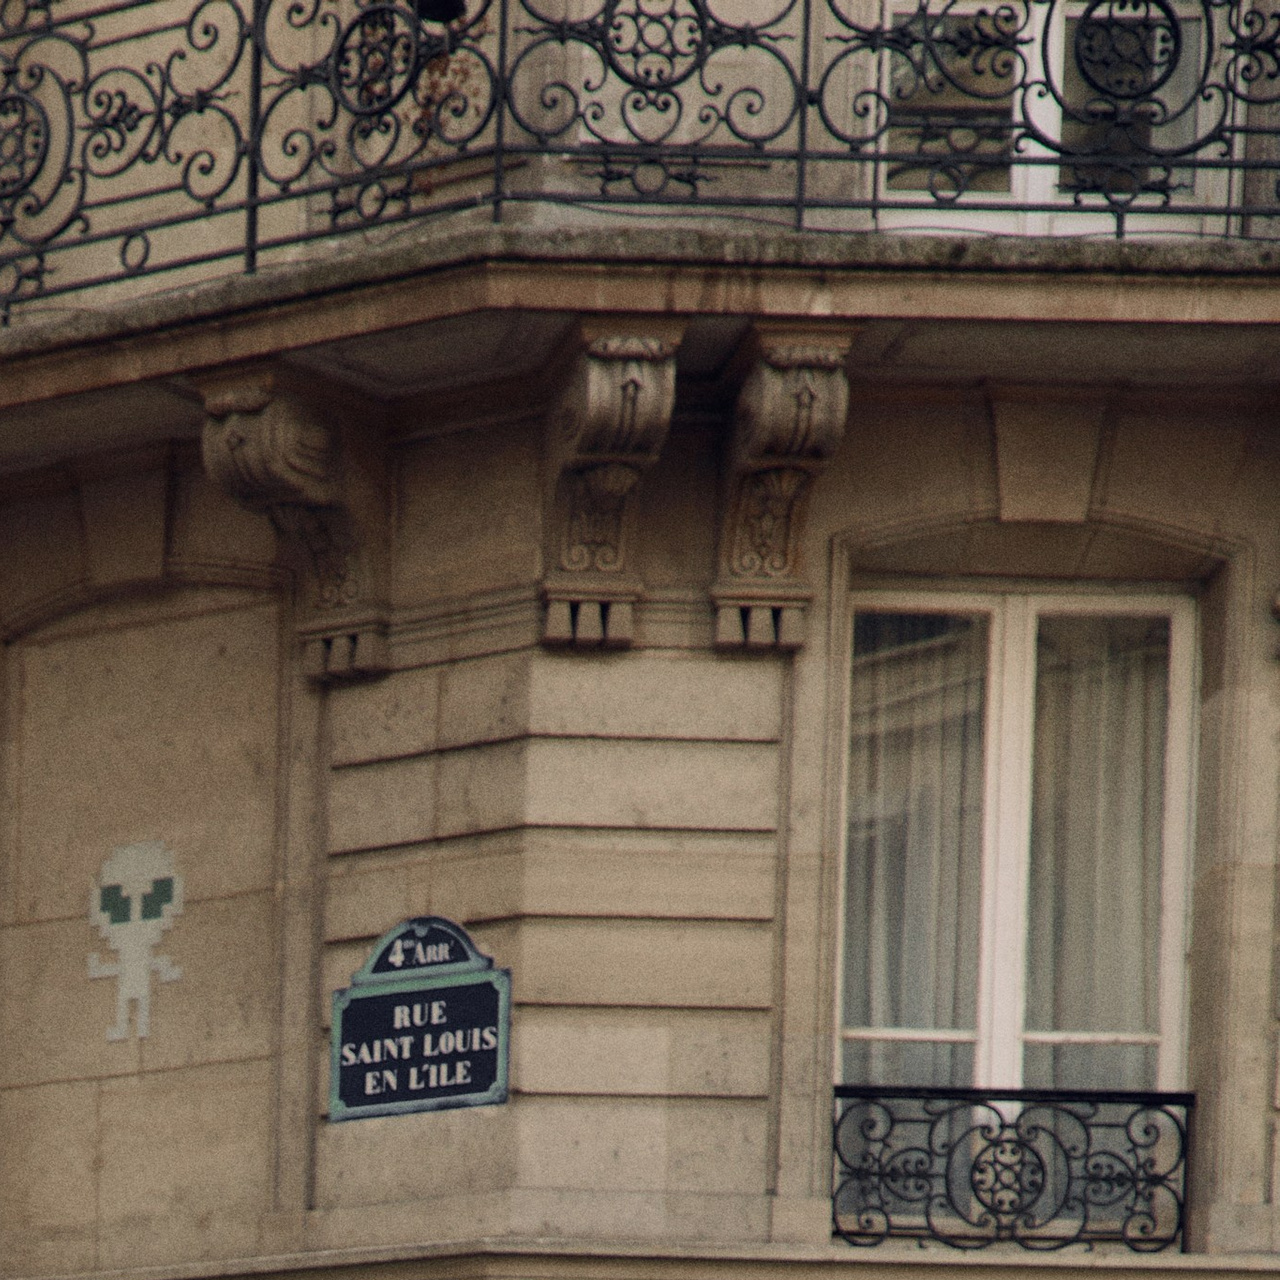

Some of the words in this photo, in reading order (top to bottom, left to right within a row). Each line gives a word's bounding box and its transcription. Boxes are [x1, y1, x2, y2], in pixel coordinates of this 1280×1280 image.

[393, 1000, 447, 1030] RUE
[341, 1035, 414, 1067] SAINT
[423, 1026, 498, 1057] LOUIS
[364, 1068, 398, 1096] EN
